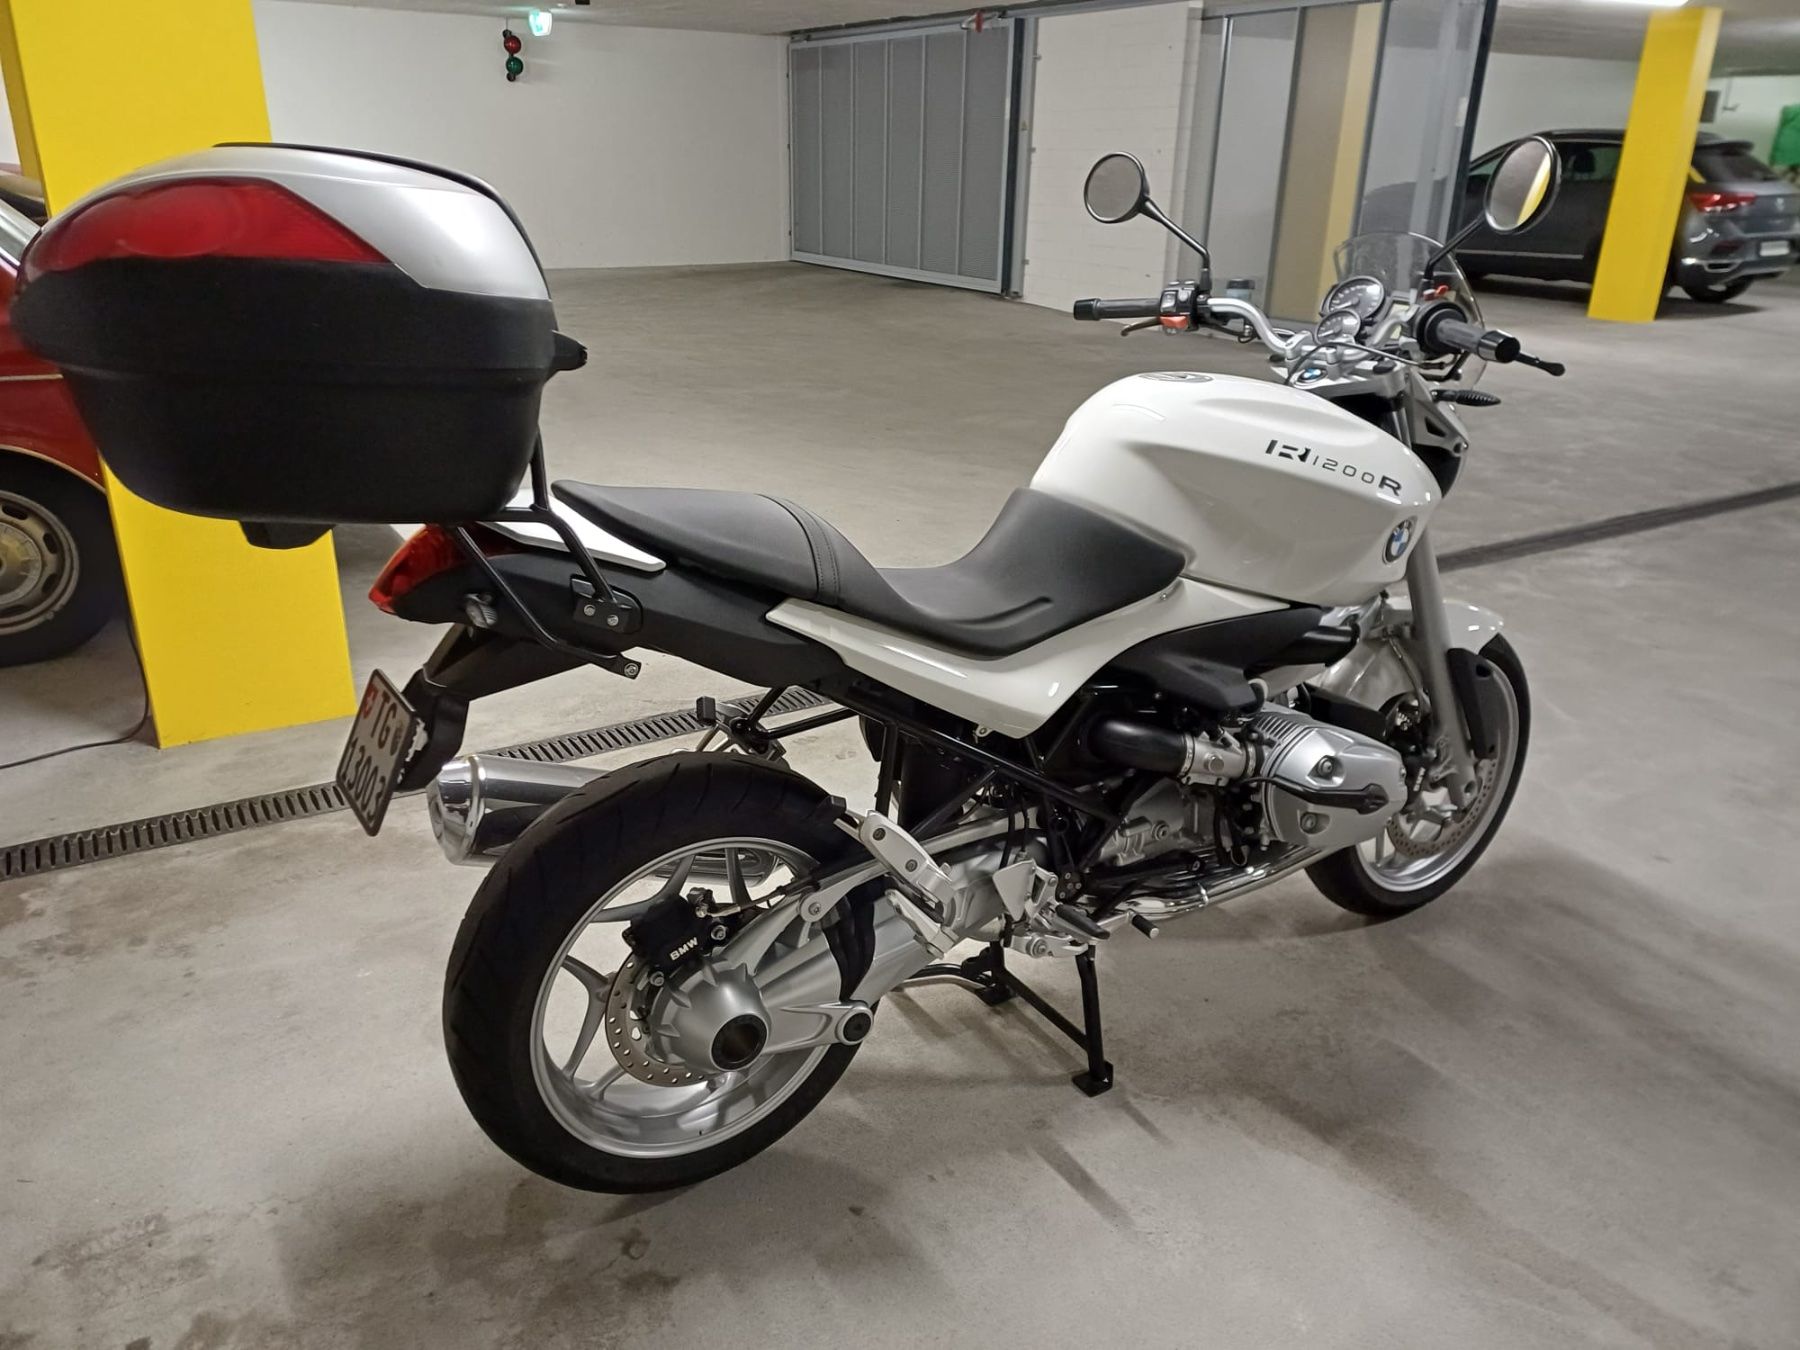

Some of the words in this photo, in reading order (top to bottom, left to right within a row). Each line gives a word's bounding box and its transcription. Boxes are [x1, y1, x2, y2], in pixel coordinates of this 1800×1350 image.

[370, 690, 397, 749] TG
[341, 737, 387, 823] 13003
[669, 936, 698, 961] BMW
